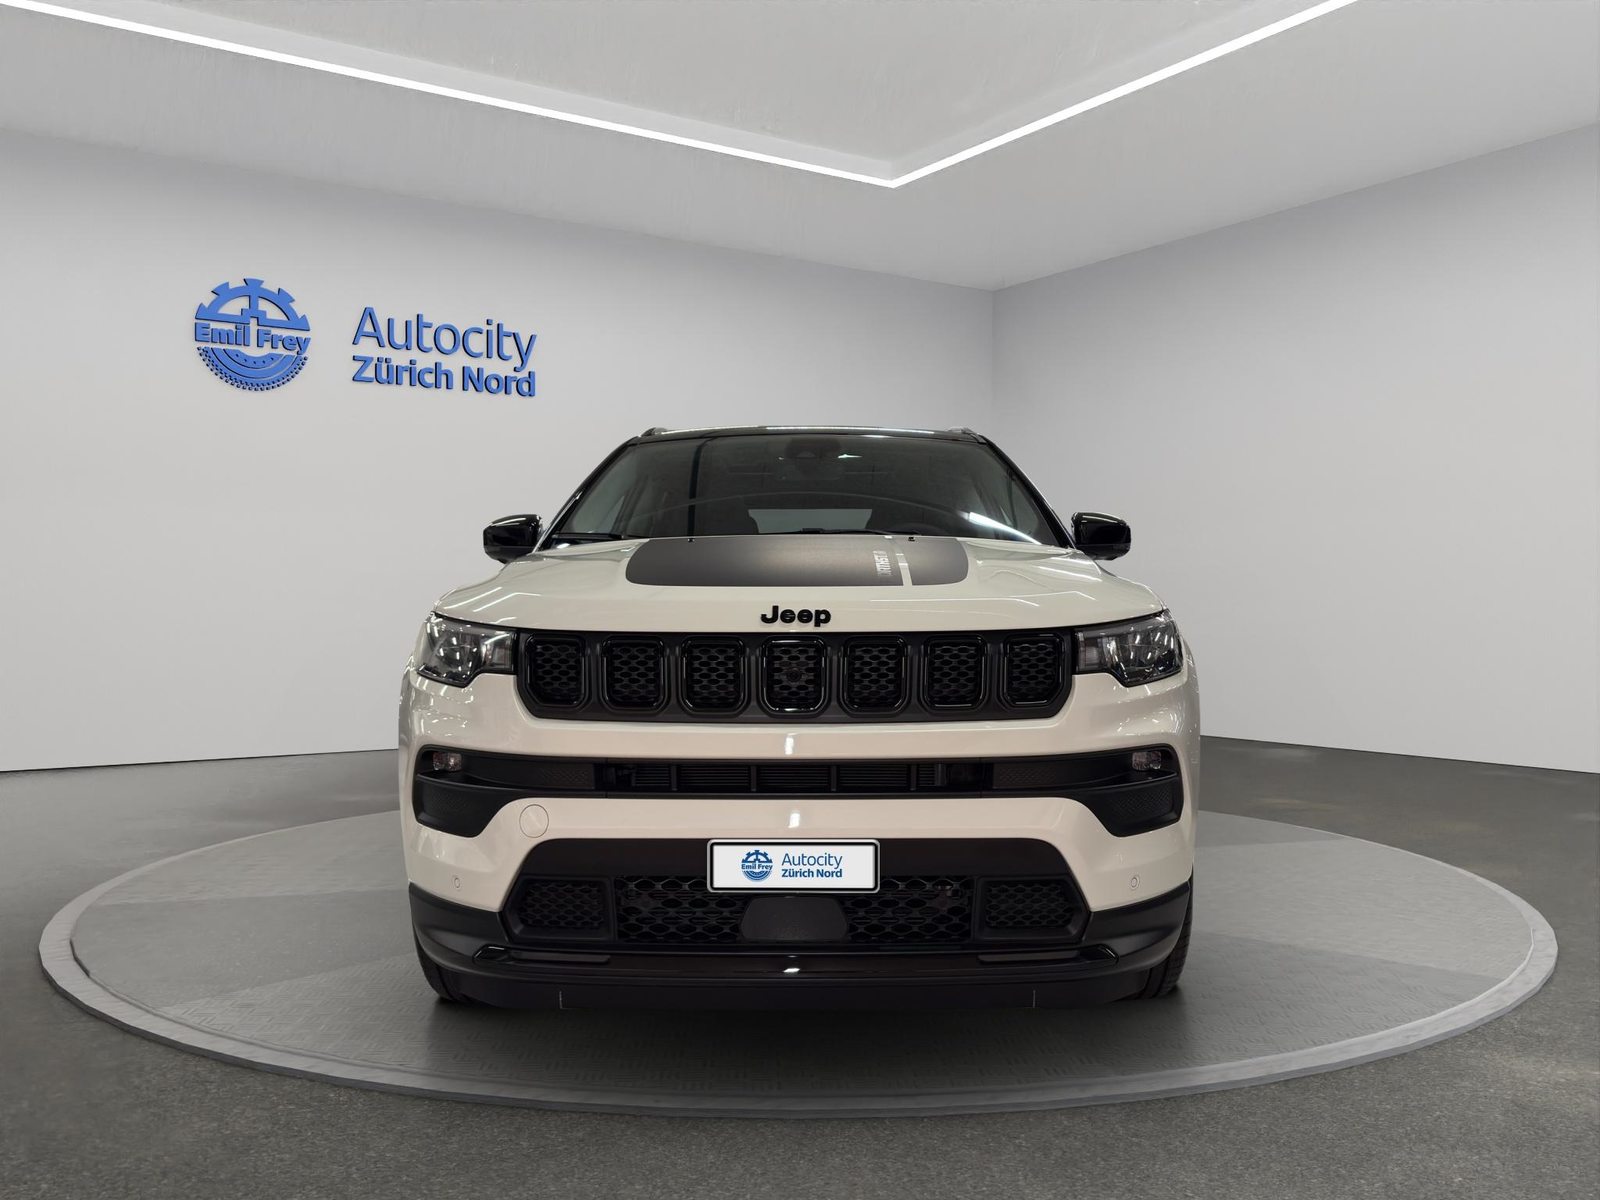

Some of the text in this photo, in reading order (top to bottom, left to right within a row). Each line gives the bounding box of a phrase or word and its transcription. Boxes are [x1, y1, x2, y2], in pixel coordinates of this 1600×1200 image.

[195, 321, 311, 356] Emil Frey
[352, 306, 537, 372] Autocity
[352, 355, 536, 397] Zürich Nord
[760, 605, 832, 628] Jeep
[758, 863, 773, 871] Frey
[781, 852, 843, 869] Autocity
[781, 868, 843, 878] Zürich Nord
